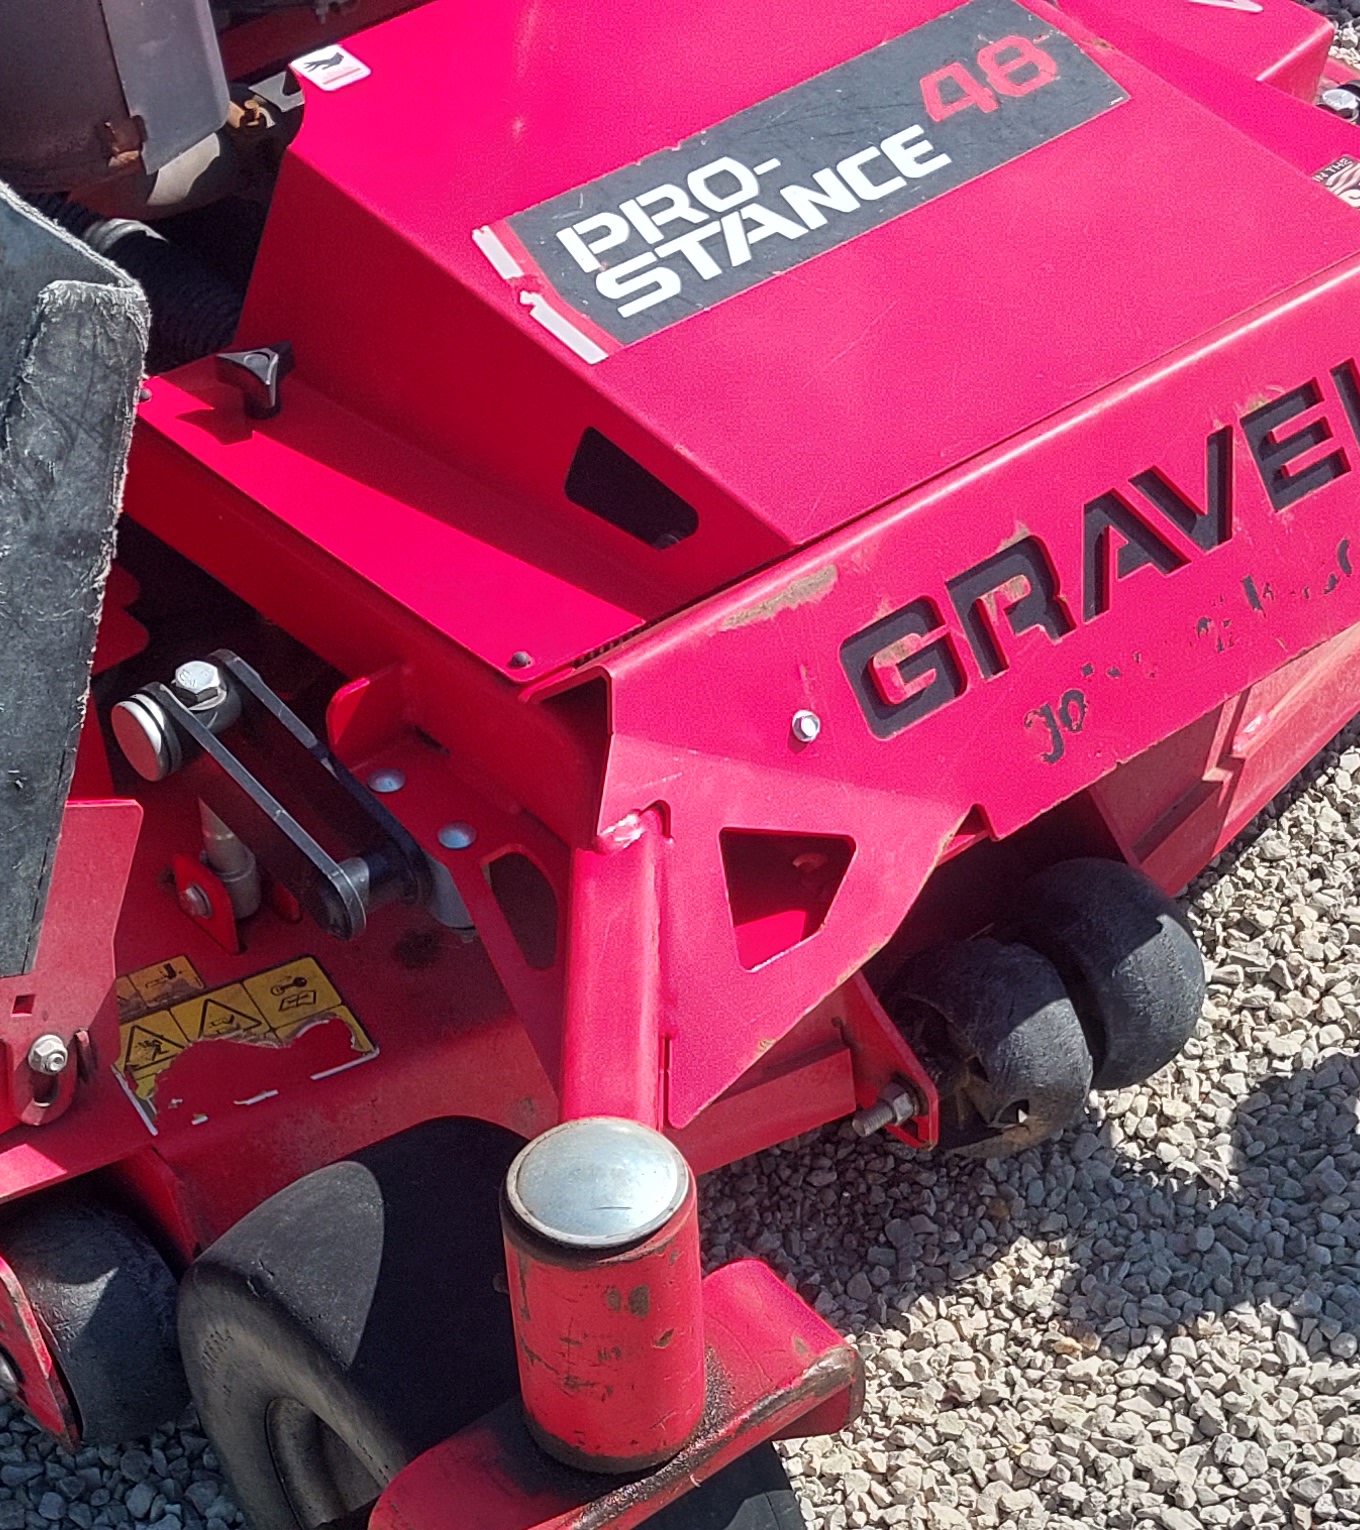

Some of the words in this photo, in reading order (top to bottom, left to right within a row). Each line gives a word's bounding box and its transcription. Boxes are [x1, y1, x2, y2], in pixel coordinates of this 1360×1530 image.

[919, 34, 1057, 122] 48
[556, 156, 781, 273] PRO-
[594, 124, 952, 318] STANCE
